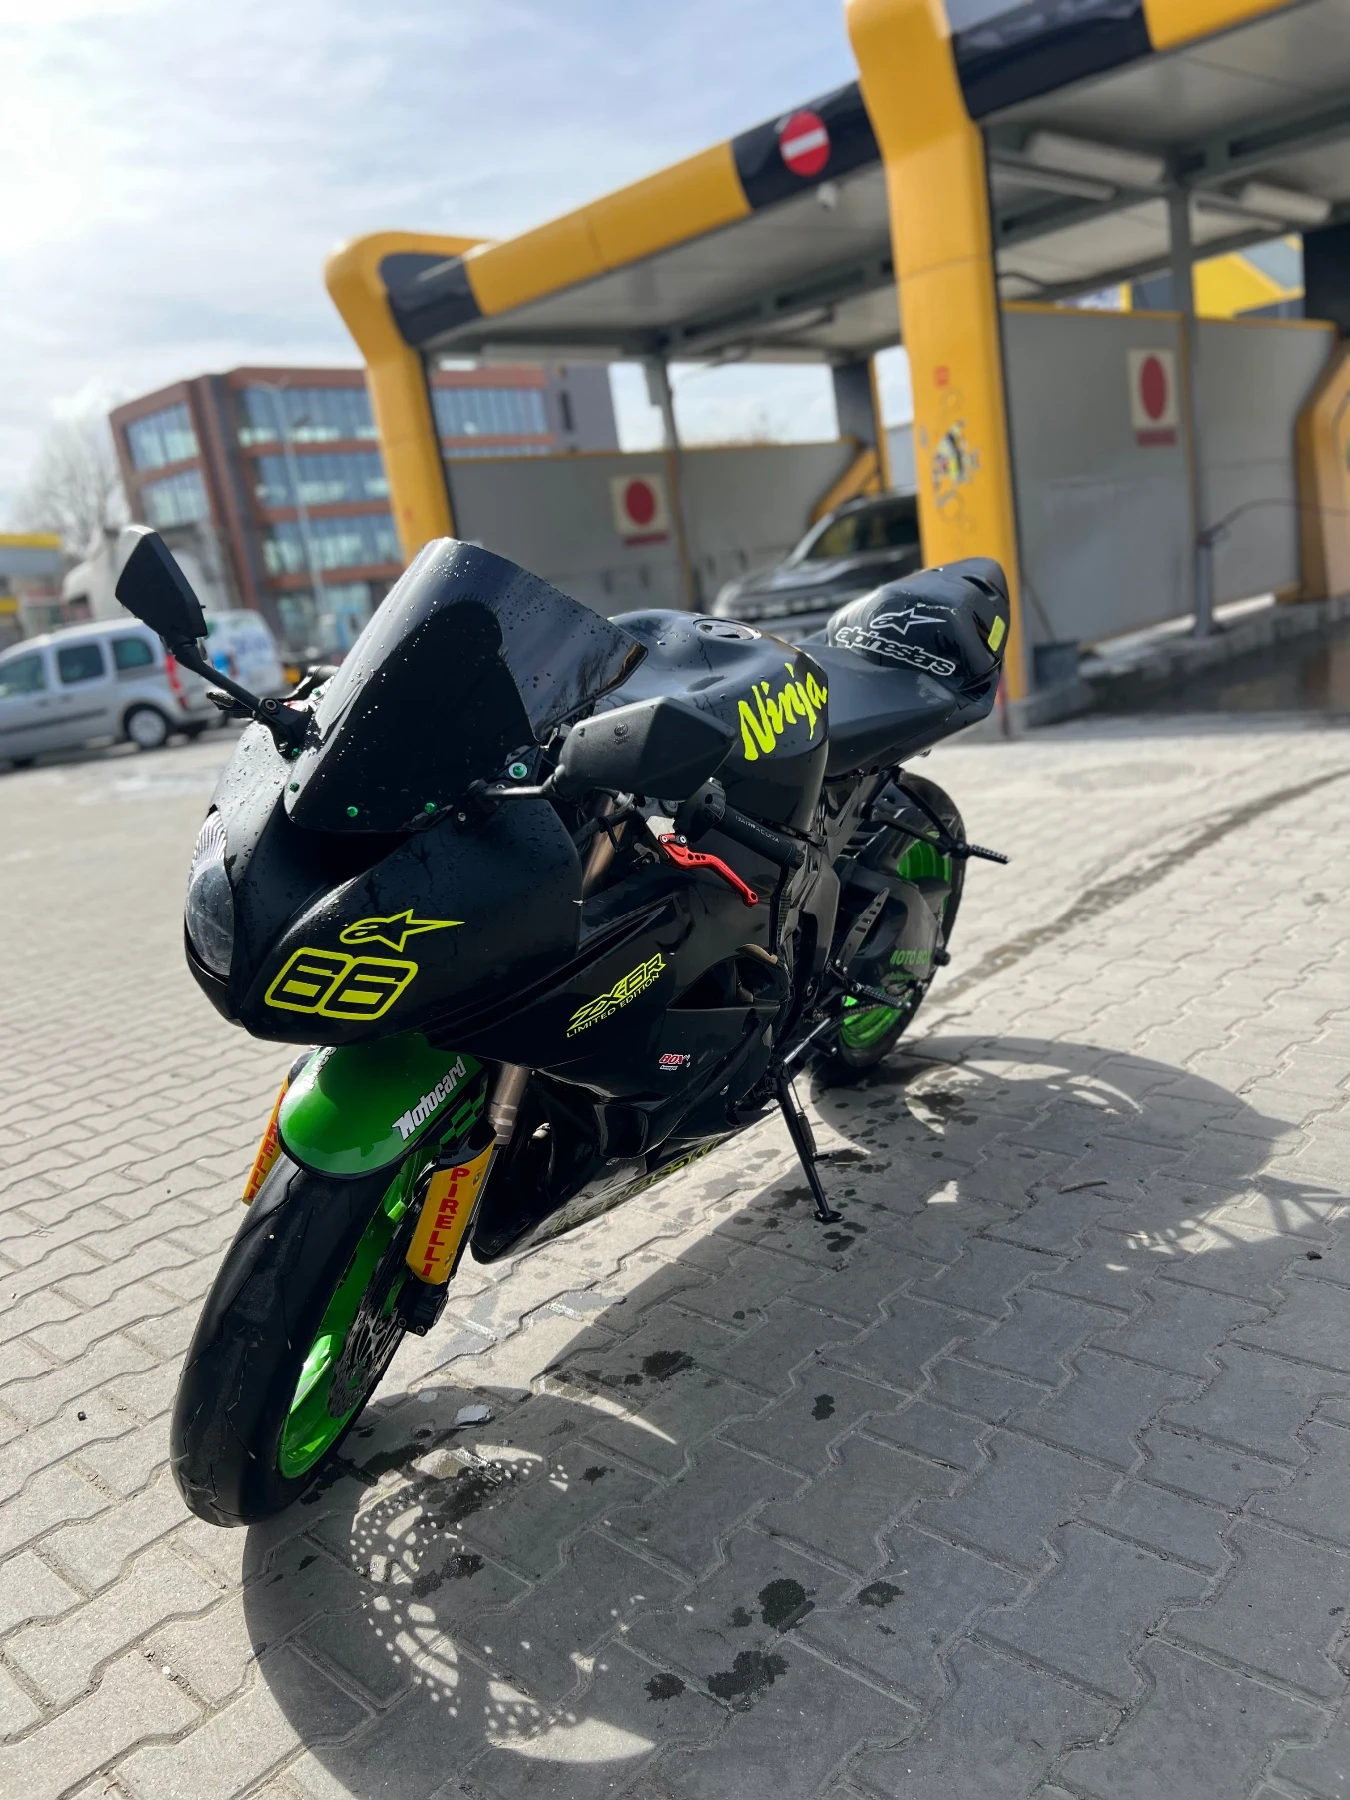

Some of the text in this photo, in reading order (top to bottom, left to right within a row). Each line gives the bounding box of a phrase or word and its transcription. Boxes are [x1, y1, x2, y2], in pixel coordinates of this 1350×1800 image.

[835, 626, 956, 676] alpinestars
[738, 662, 828, 761] Ninja
[264, 947, 419, 1021] 66
[566, 972, 660, 1038] LIMITED EDITION
[392, 1056, 467, 1141] Motocard
[422, 1166, 470, 1277] PIRELLI
